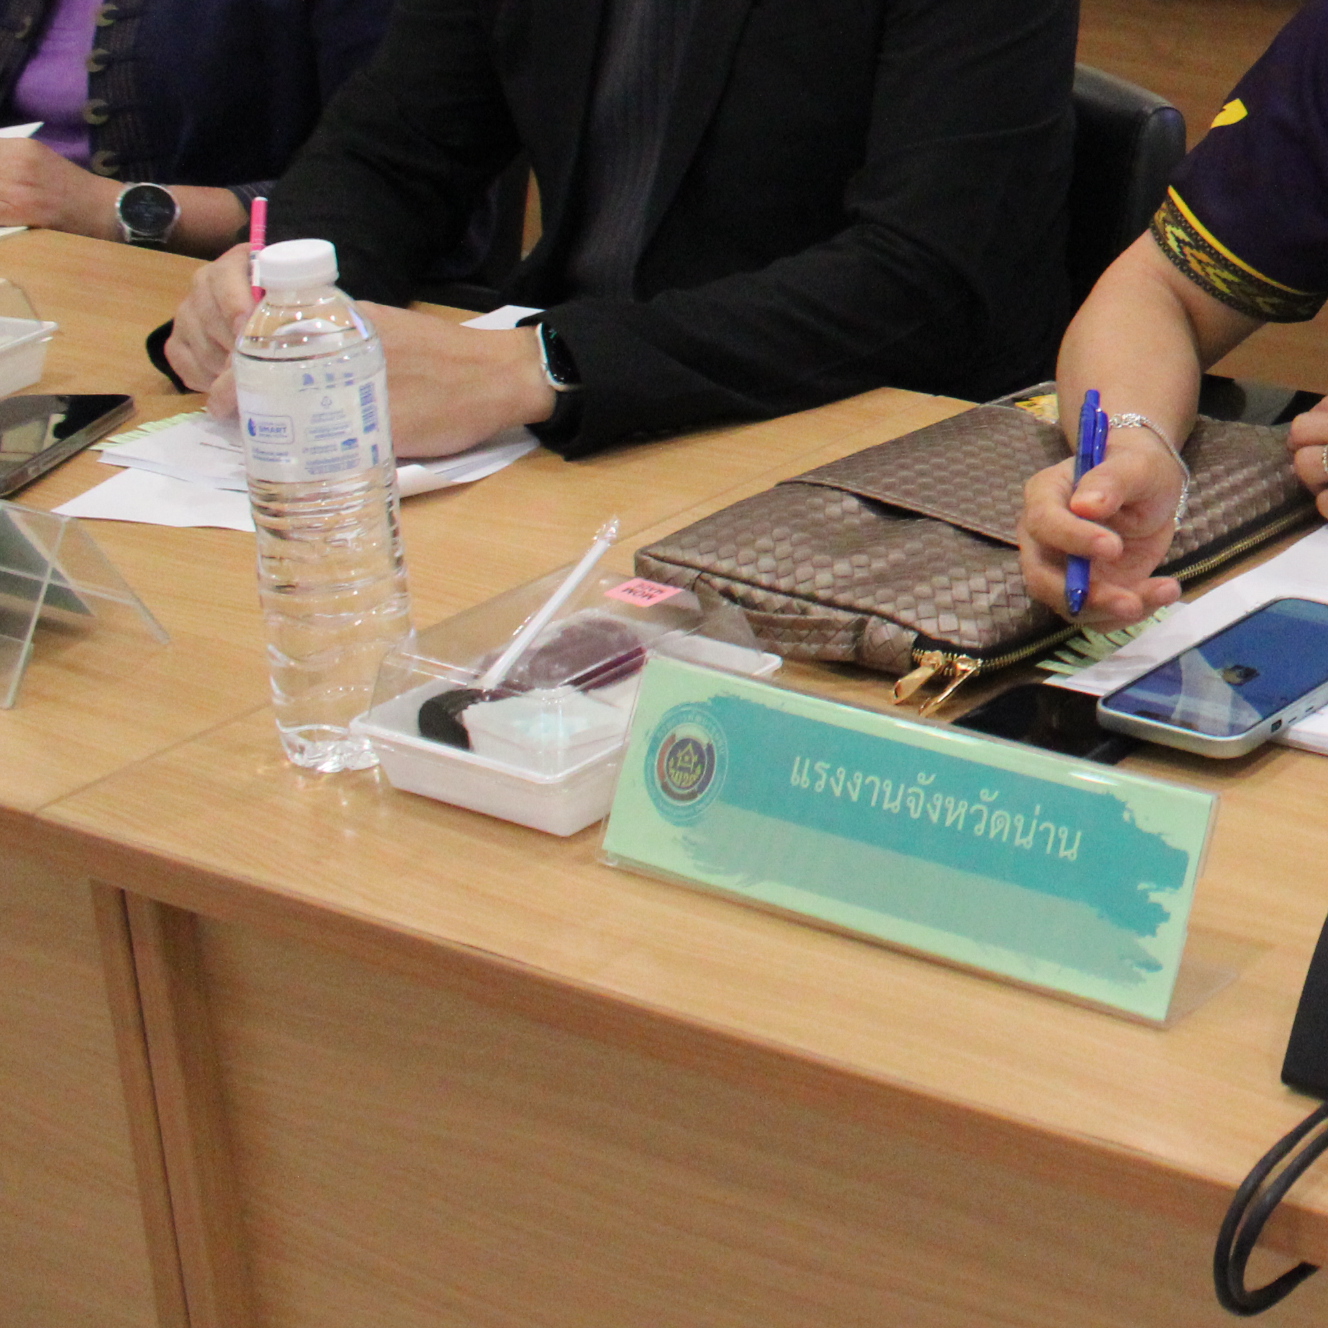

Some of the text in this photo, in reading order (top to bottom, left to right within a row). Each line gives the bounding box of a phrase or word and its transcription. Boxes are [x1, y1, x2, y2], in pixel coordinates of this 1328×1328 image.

[790, 756, 1082, 861] แรงงานจังหวัดน่าน
